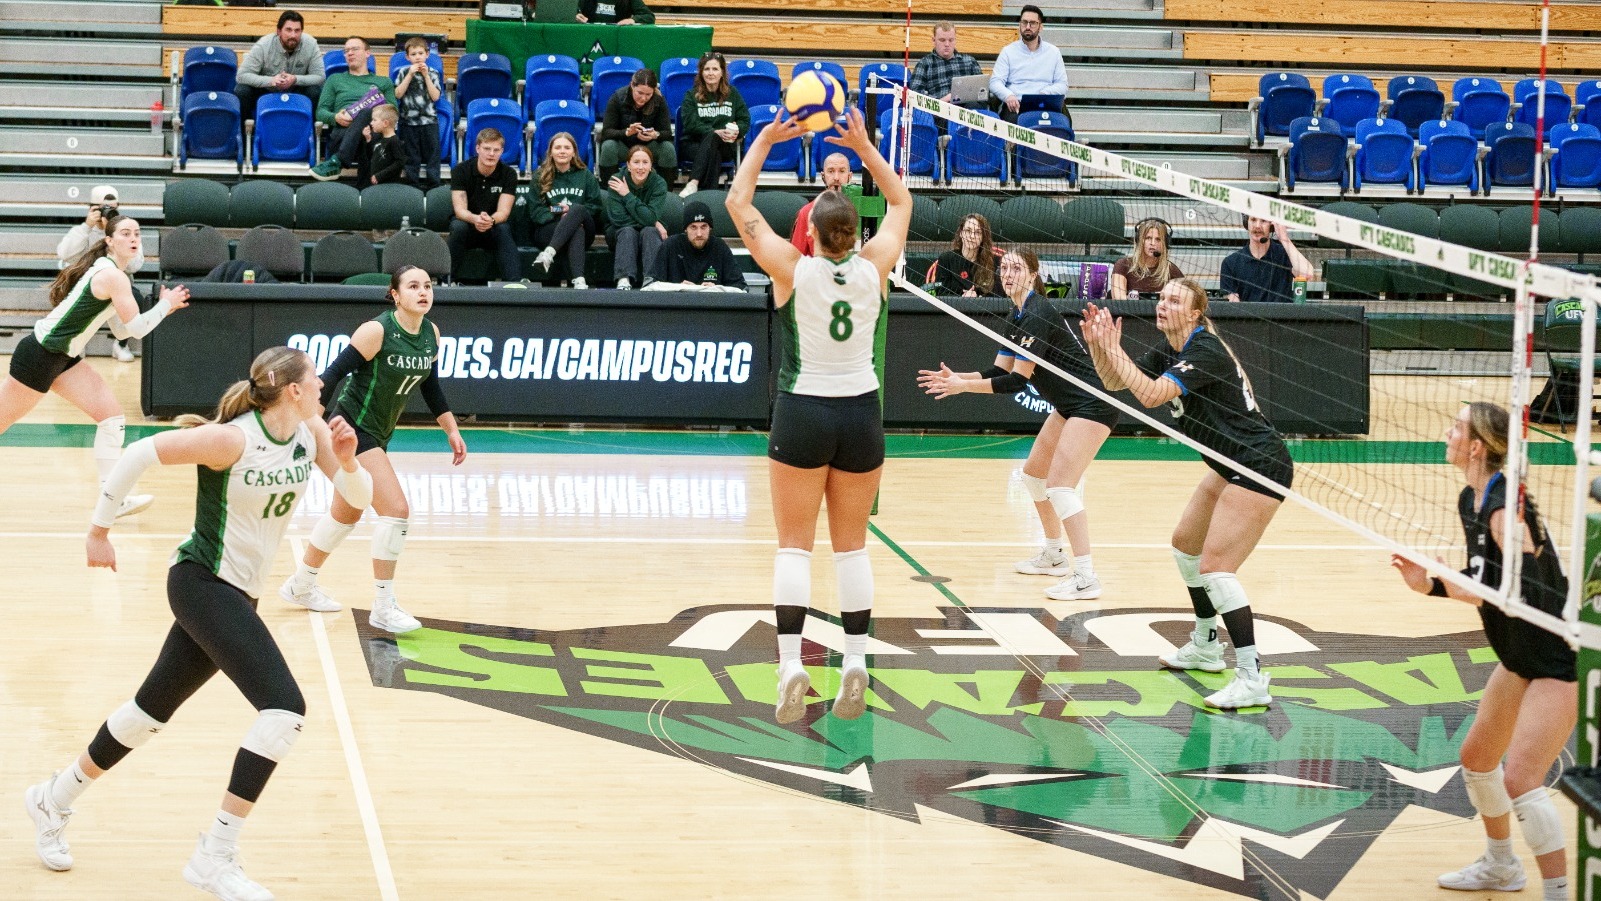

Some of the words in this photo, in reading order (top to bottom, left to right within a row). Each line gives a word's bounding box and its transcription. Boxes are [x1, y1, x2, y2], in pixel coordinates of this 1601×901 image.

[697, 105, 733, 118] CASCADES
[829, 301, 853, 342] 8
[396, 375, 423, 395] 17
[1014, 391, 1057, 414] CAMPU
[262, 491, 296, 519] 18
[668, 609, 1321, 657] UFV
